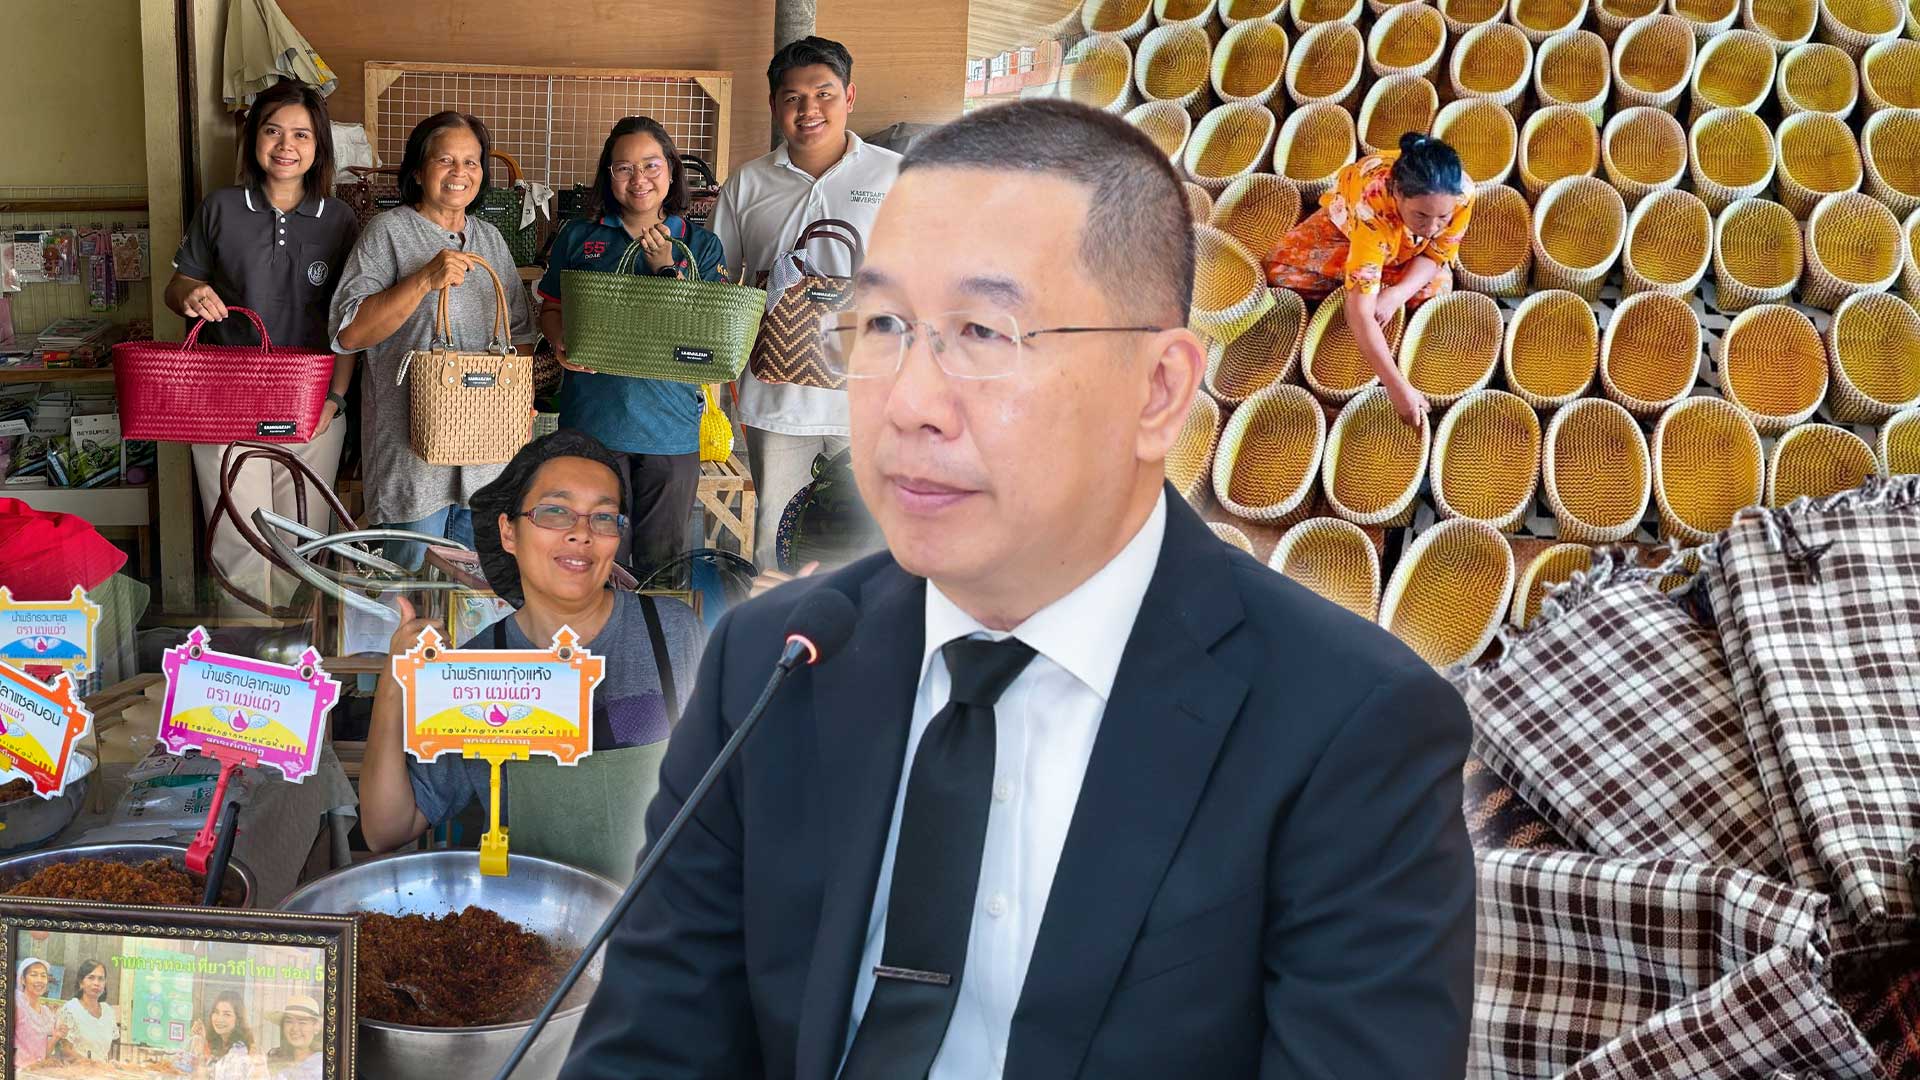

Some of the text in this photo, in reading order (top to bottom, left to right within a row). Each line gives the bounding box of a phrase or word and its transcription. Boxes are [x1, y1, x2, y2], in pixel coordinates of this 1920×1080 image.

[850, 196, 881, 204] UNIVERSIT
[201, 664, 291, 696] น้ำพริกปลากะพง
[442, 664, 551, 684] น้ำพริกเผากุ้งแห้ง
[206, 686, 230, 702] ตรา
[453, 686, 480, 700] ตรา
[0, 681, 61, 726] ลาแซลมอน
